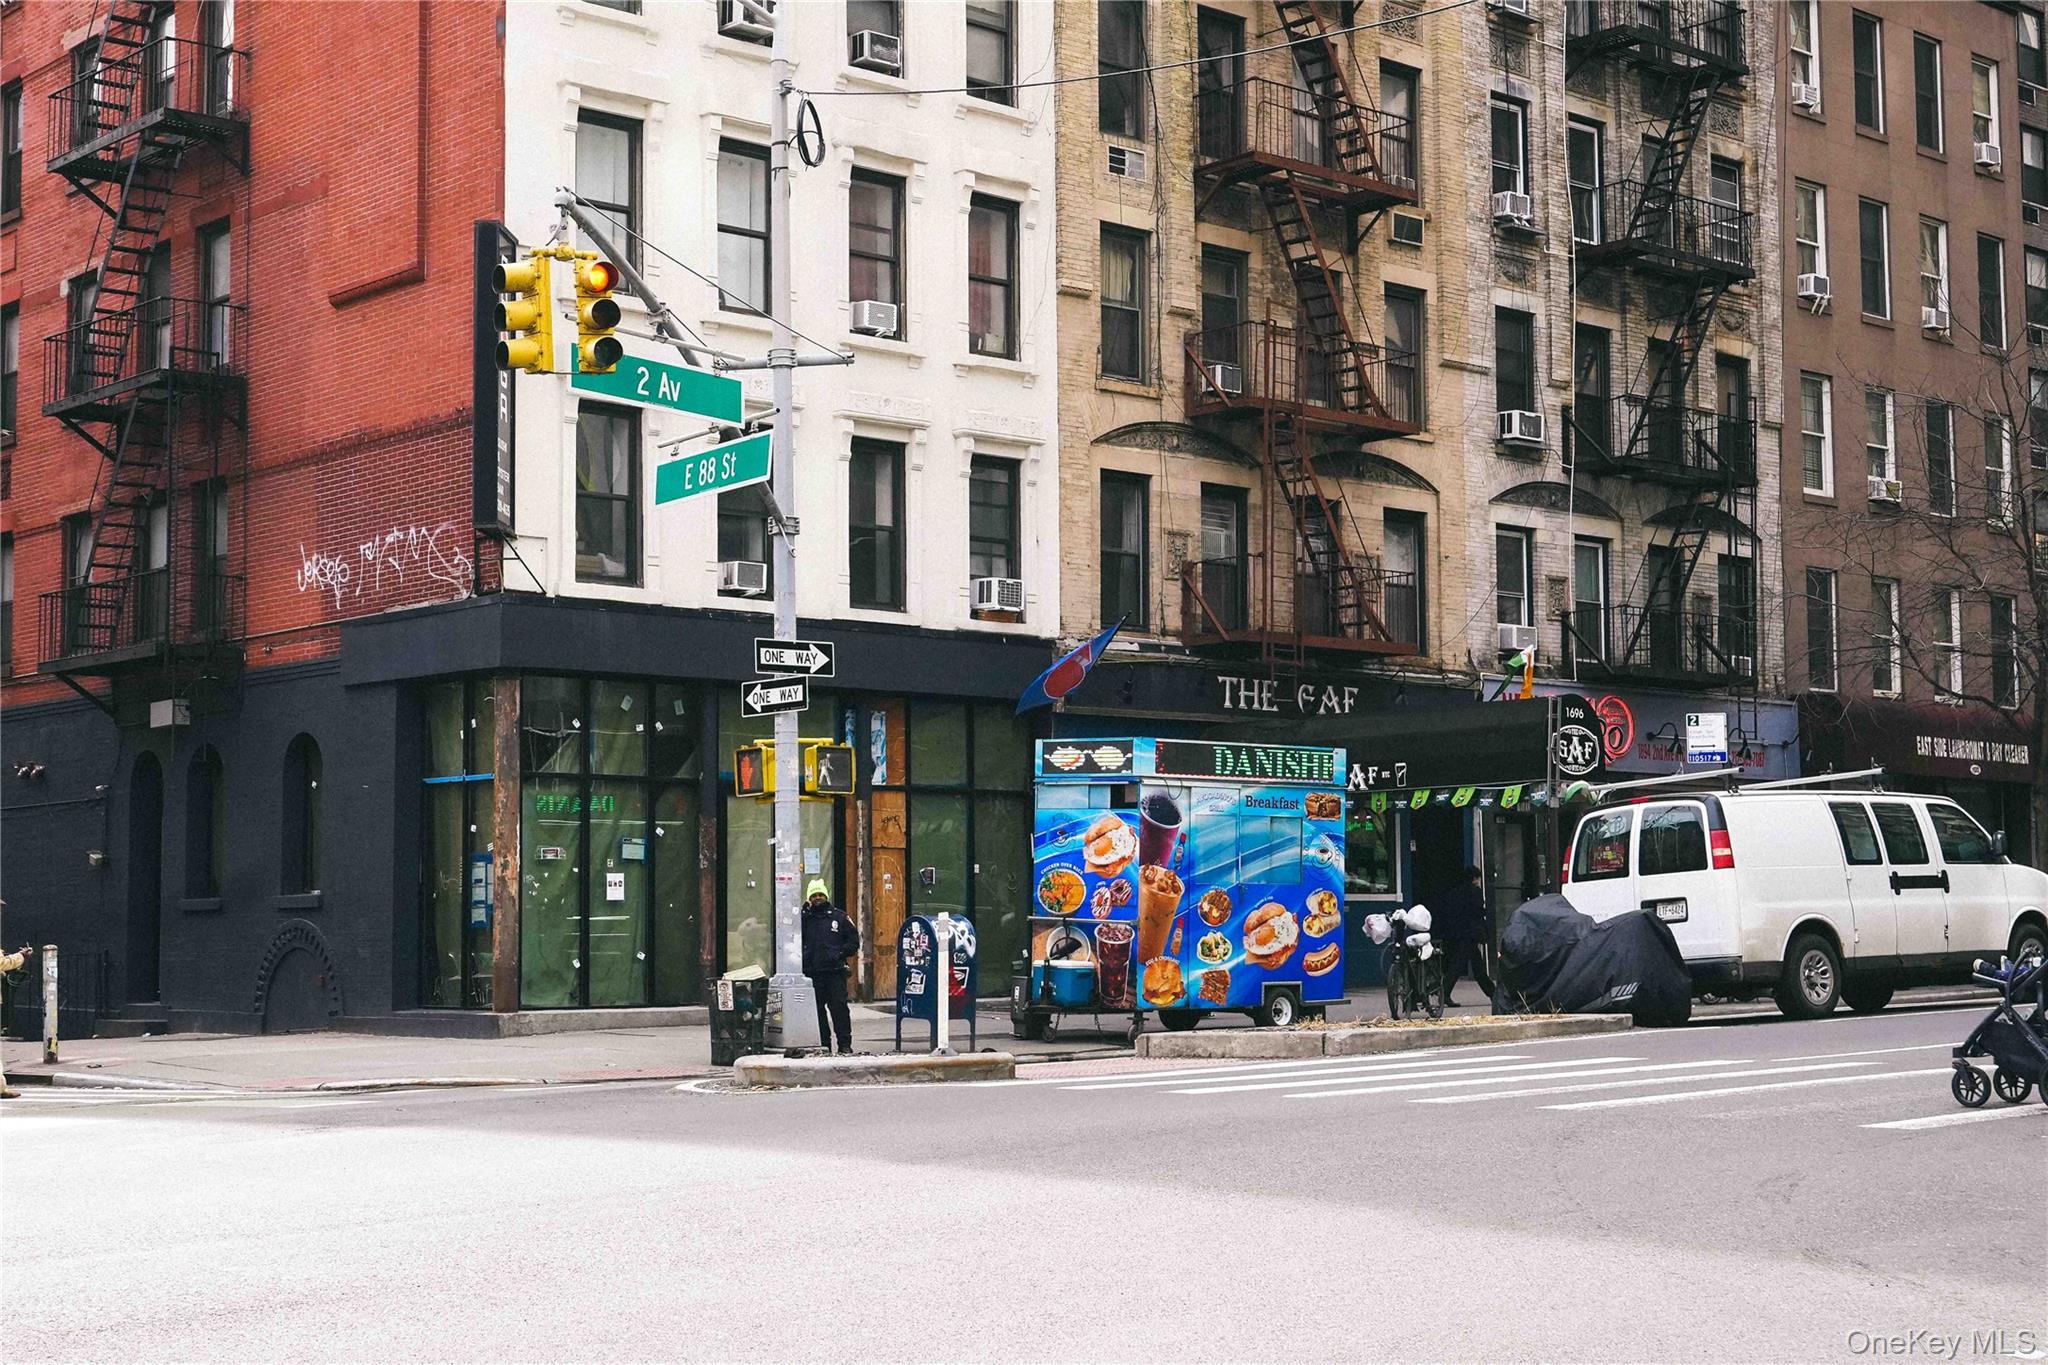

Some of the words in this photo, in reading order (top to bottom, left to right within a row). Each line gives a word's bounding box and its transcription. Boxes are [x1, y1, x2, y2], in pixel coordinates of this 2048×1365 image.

[637, 366, 650, 396] 2
[658, 371, 681, 402] Av
[684, 463, 694, 490] E
[699, 456, 717, 487] 88
[721, 451, 737, 480] St
[764, 650, 785, 663] ONE
[795, 651, 818, 665] WAY
[752, 691, 771, 705] ONE
[779, 687, 799, 702] WAY
[1217, 676, 1279, 712] THE
[1565, 706, 1585, 719] 1696
[1689, 715, 1698, 726] 2
[1559, 736, 1594, 765] GAF
[1916, 735, 1932, 756] EAST
[1933, 737, 1948, 758] SIDE
[1948, 738, 1984, 760] LAUNDROMAT
[1991, 742, 2003, 762] DRY
[2004, 743, 2029, 765] CLEANER
[1347, 763, 1379, 791] AF
[1245, 795, 1300, 810] Breakfast
[1040, 862, 1060, 875] CHICKEN
[1073, 865, 1084, 876] RICE
